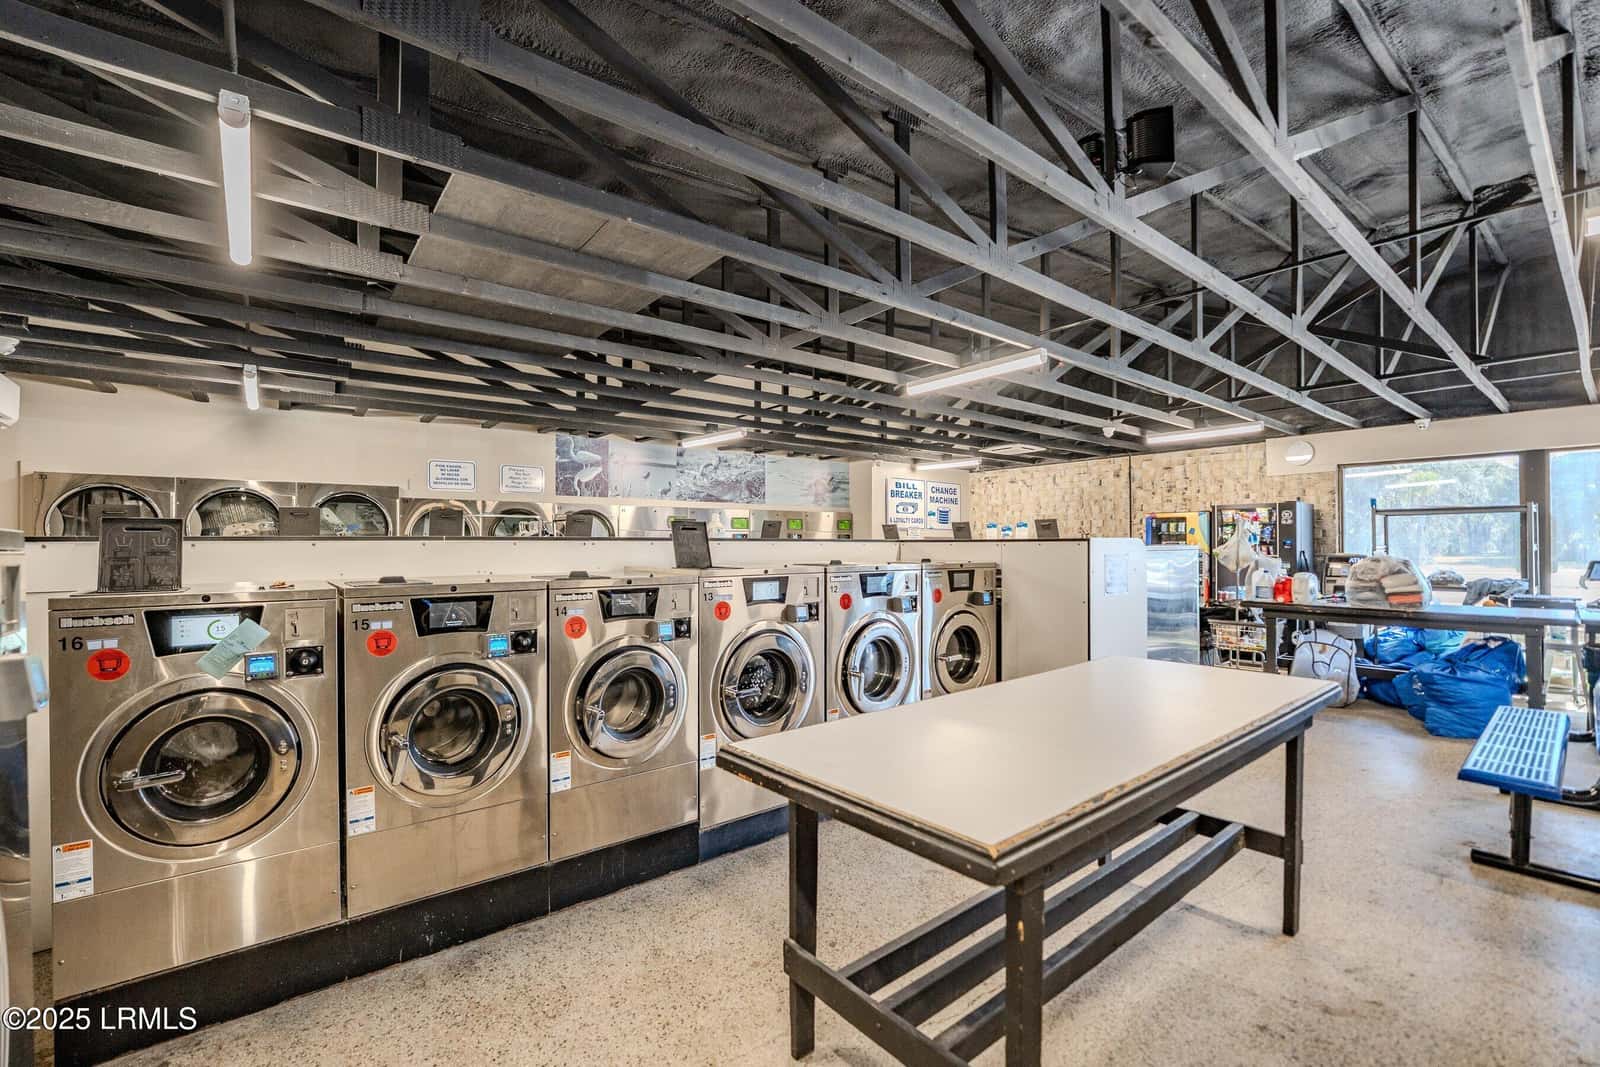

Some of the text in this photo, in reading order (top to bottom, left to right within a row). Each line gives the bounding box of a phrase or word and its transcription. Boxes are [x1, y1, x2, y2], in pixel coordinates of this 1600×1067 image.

[895, 481, 918, 490] BILL
[890, 489, 923, 500] BREAKER
[931, 486, 958, 496] CHANGE
[929, 496, 959, 505] MACHINE
[703, 592, 714, 601] 13
[554, 606, 568, 617] 14
[351, 618, 370, 631] 15
[58, 636, 84, 651] 16
